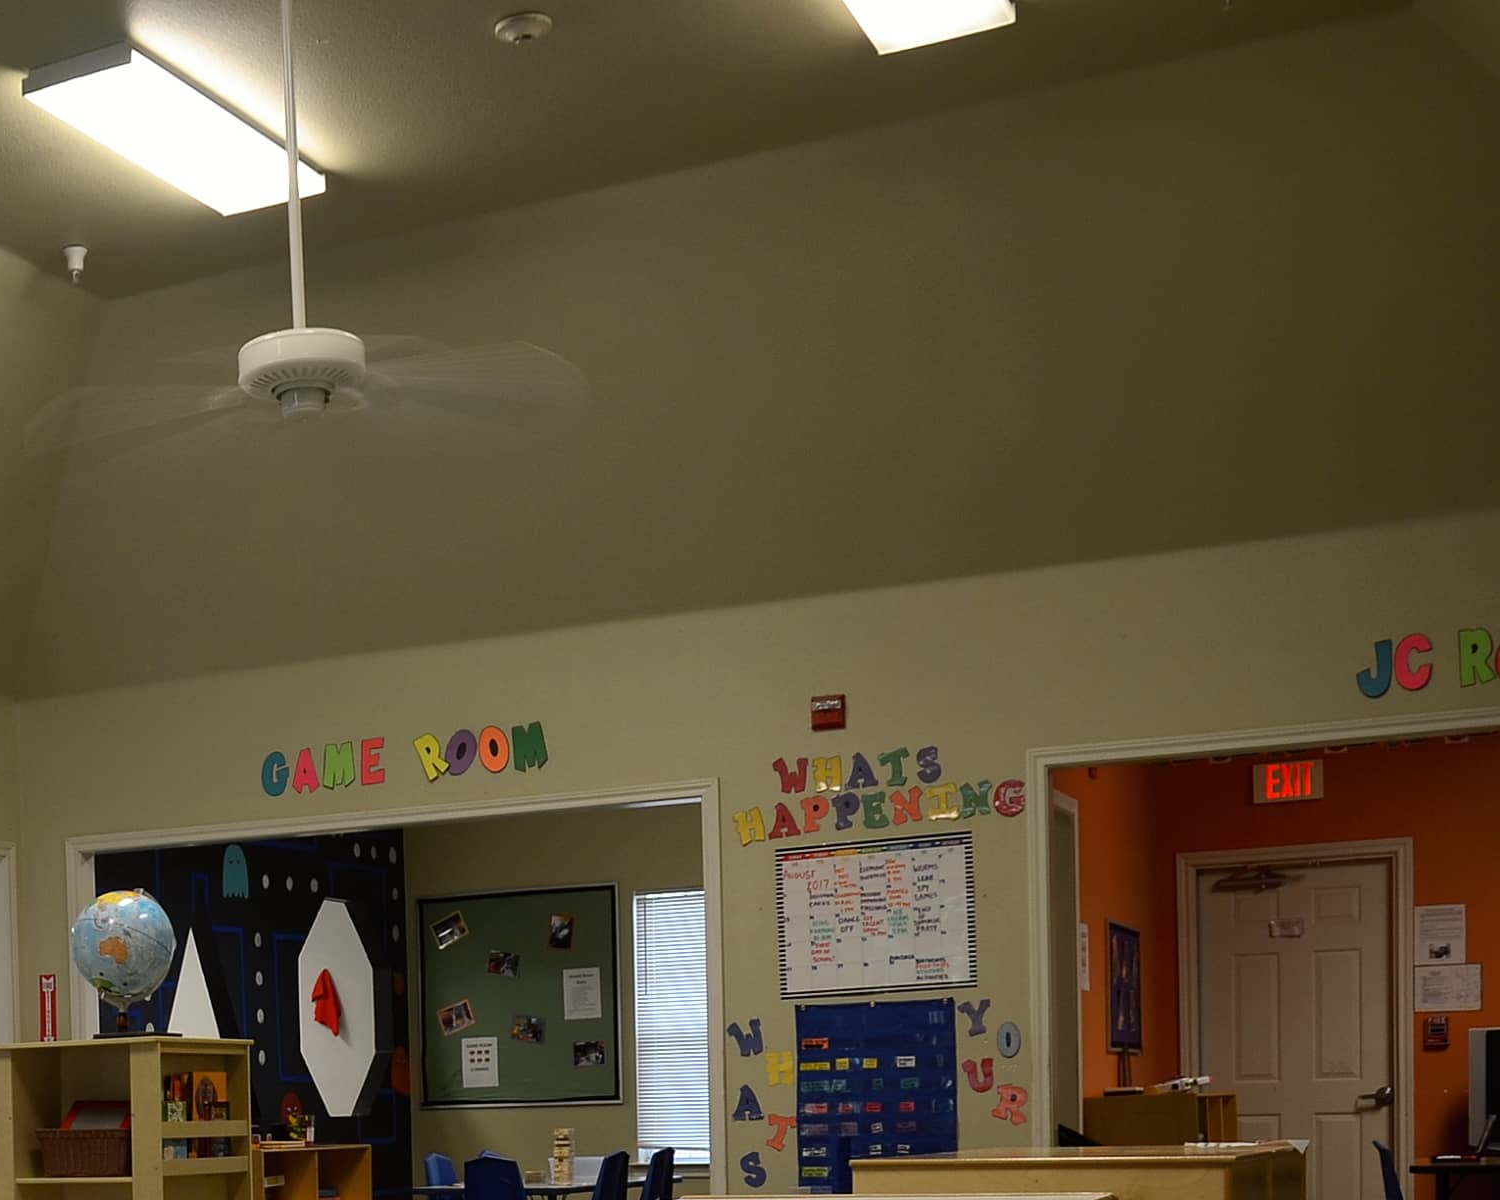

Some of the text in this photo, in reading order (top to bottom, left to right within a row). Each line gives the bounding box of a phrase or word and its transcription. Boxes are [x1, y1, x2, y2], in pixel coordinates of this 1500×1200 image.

[1356, 626, 1500, 699] JC R
[261, 720, 549, 797] GAME ROOM
[772, 745, 942, 794] WHATS
[1266, 760, 1315, 800] EXIT
[732, 779, 1027, 847] HAPPENING
[783, 869, 816, 881] AUGUST
[806, 879, 831, 891] 2017
[840, 925, 854, 934] OFF
